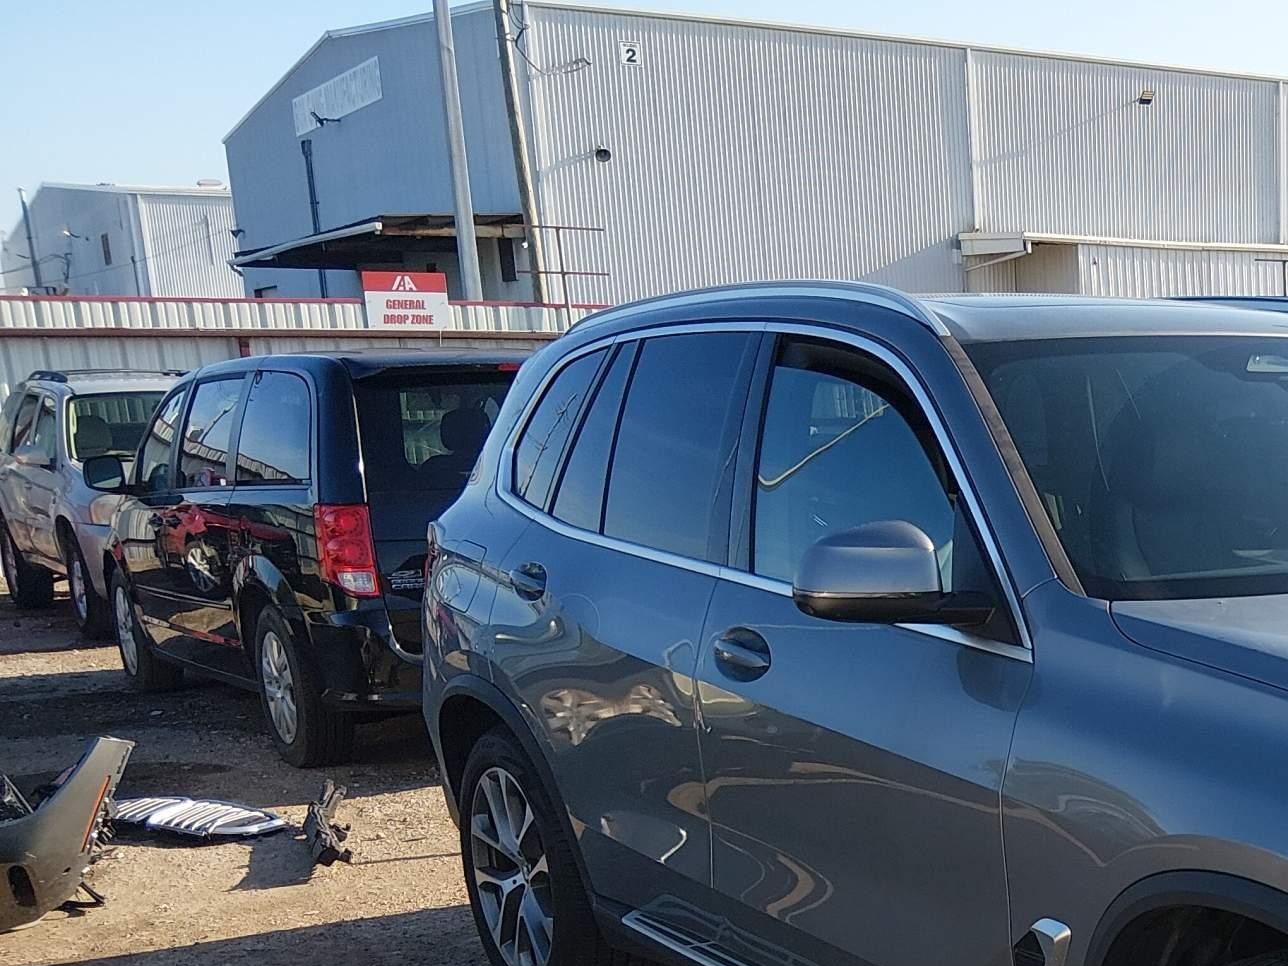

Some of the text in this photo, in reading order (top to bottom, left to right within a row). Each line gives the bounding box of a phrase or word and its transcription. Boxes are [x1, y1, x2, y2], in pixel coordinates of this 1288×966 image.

[625, 48, 637, 63] 2
[385, 299, 426, 310] GENERAL
[383, 314, 434, 325] DROP ZONE
